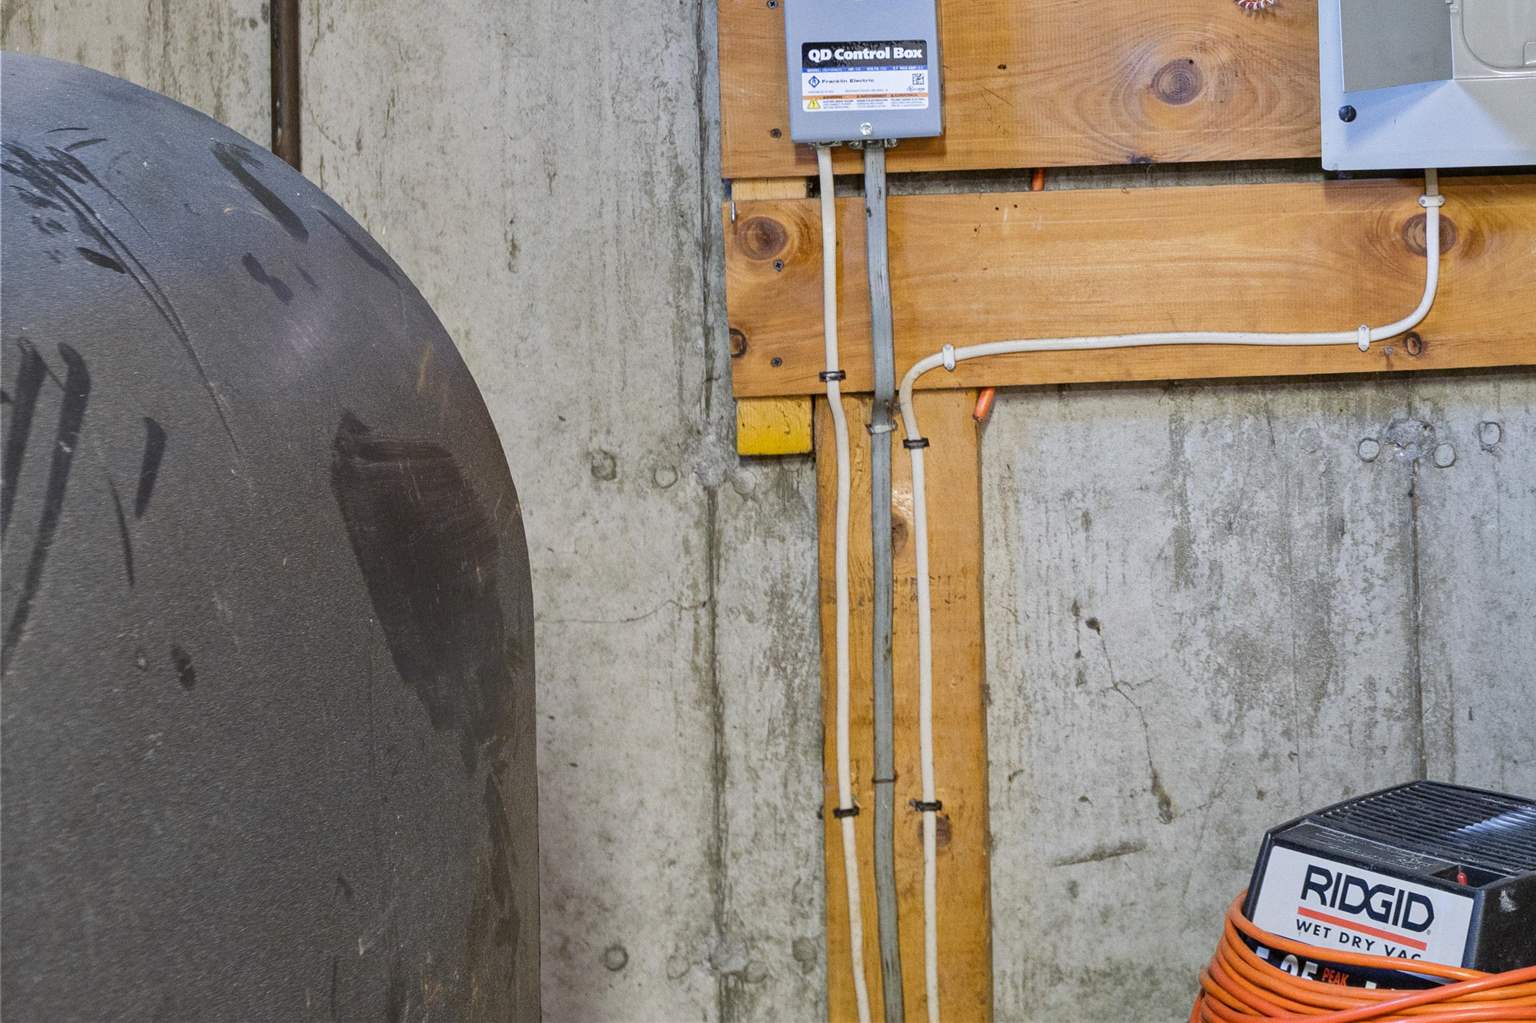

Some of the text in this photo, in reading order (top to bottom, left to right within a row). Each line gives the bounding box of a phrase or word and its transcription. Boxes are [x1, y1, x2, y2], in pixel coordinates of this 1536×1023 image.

[808, 46, 923, 63] QD Control Box
[1300, 864, 1435, 933] RIDGID
[1296, 919, 1331, 938] WET
[1339, 932, 1375, 951] DRY
